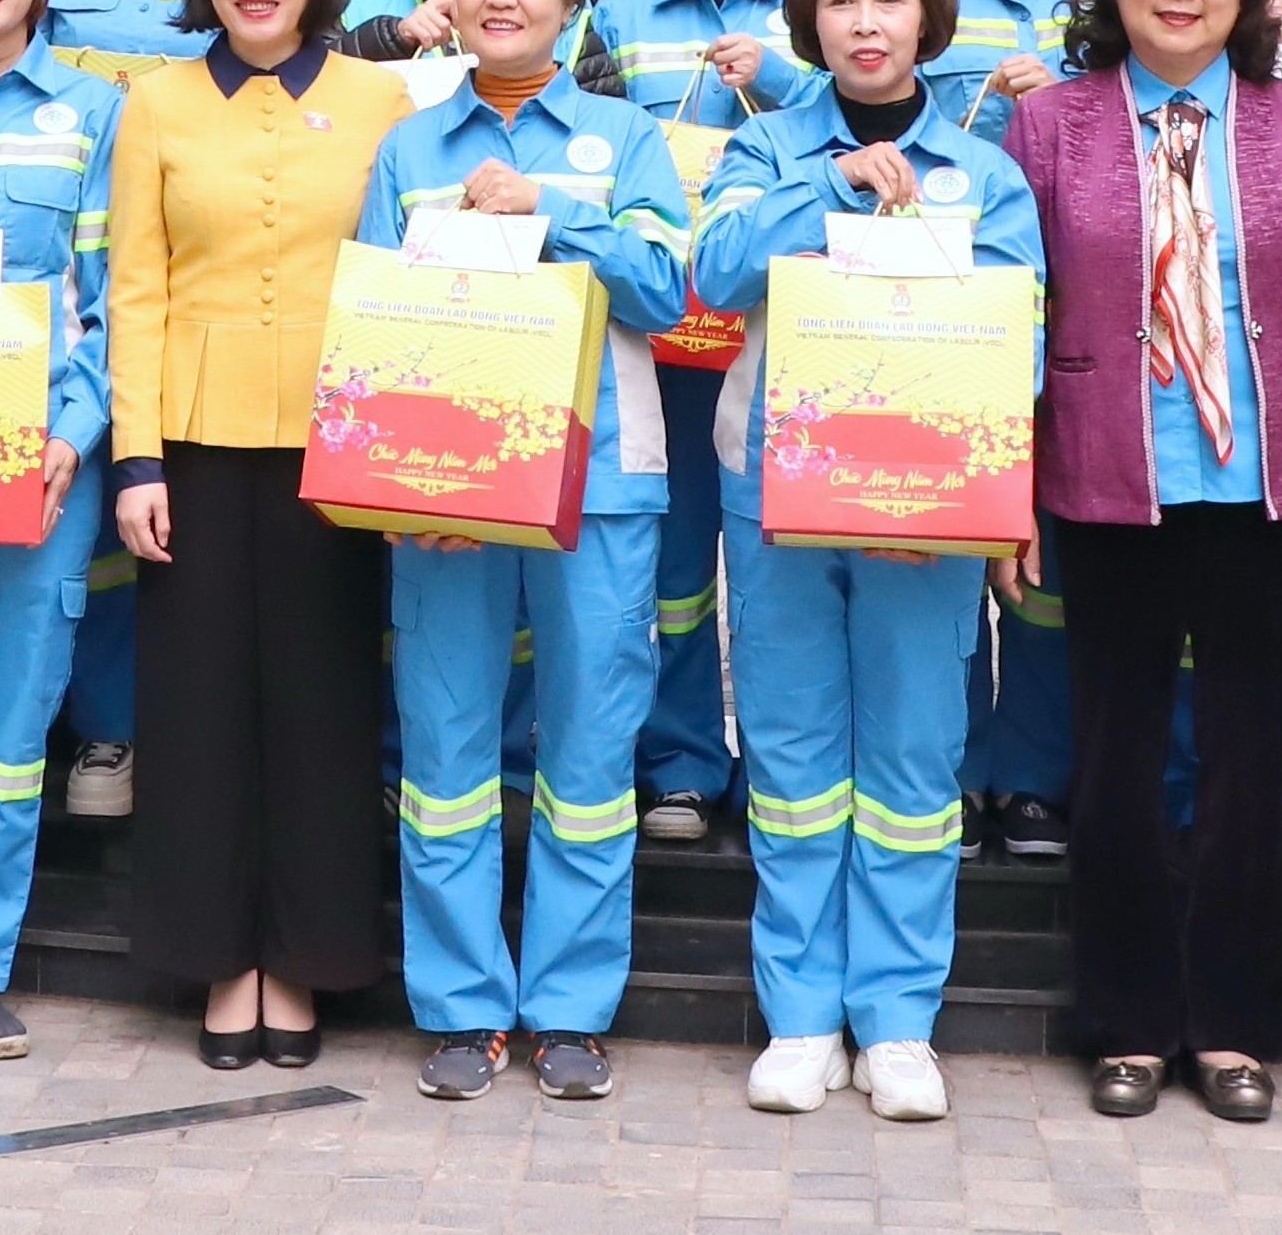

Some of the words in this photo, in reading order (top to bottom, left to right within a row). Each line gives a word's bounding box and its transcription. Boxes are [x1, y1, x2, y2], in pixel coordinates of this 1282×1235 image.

[394, 467, 422, 476] HAPPY
[445, 472, 469, 481] YEAR
[859, 490, 889, 498] HAPPY
[913, 492, 938, 500] YEAR
